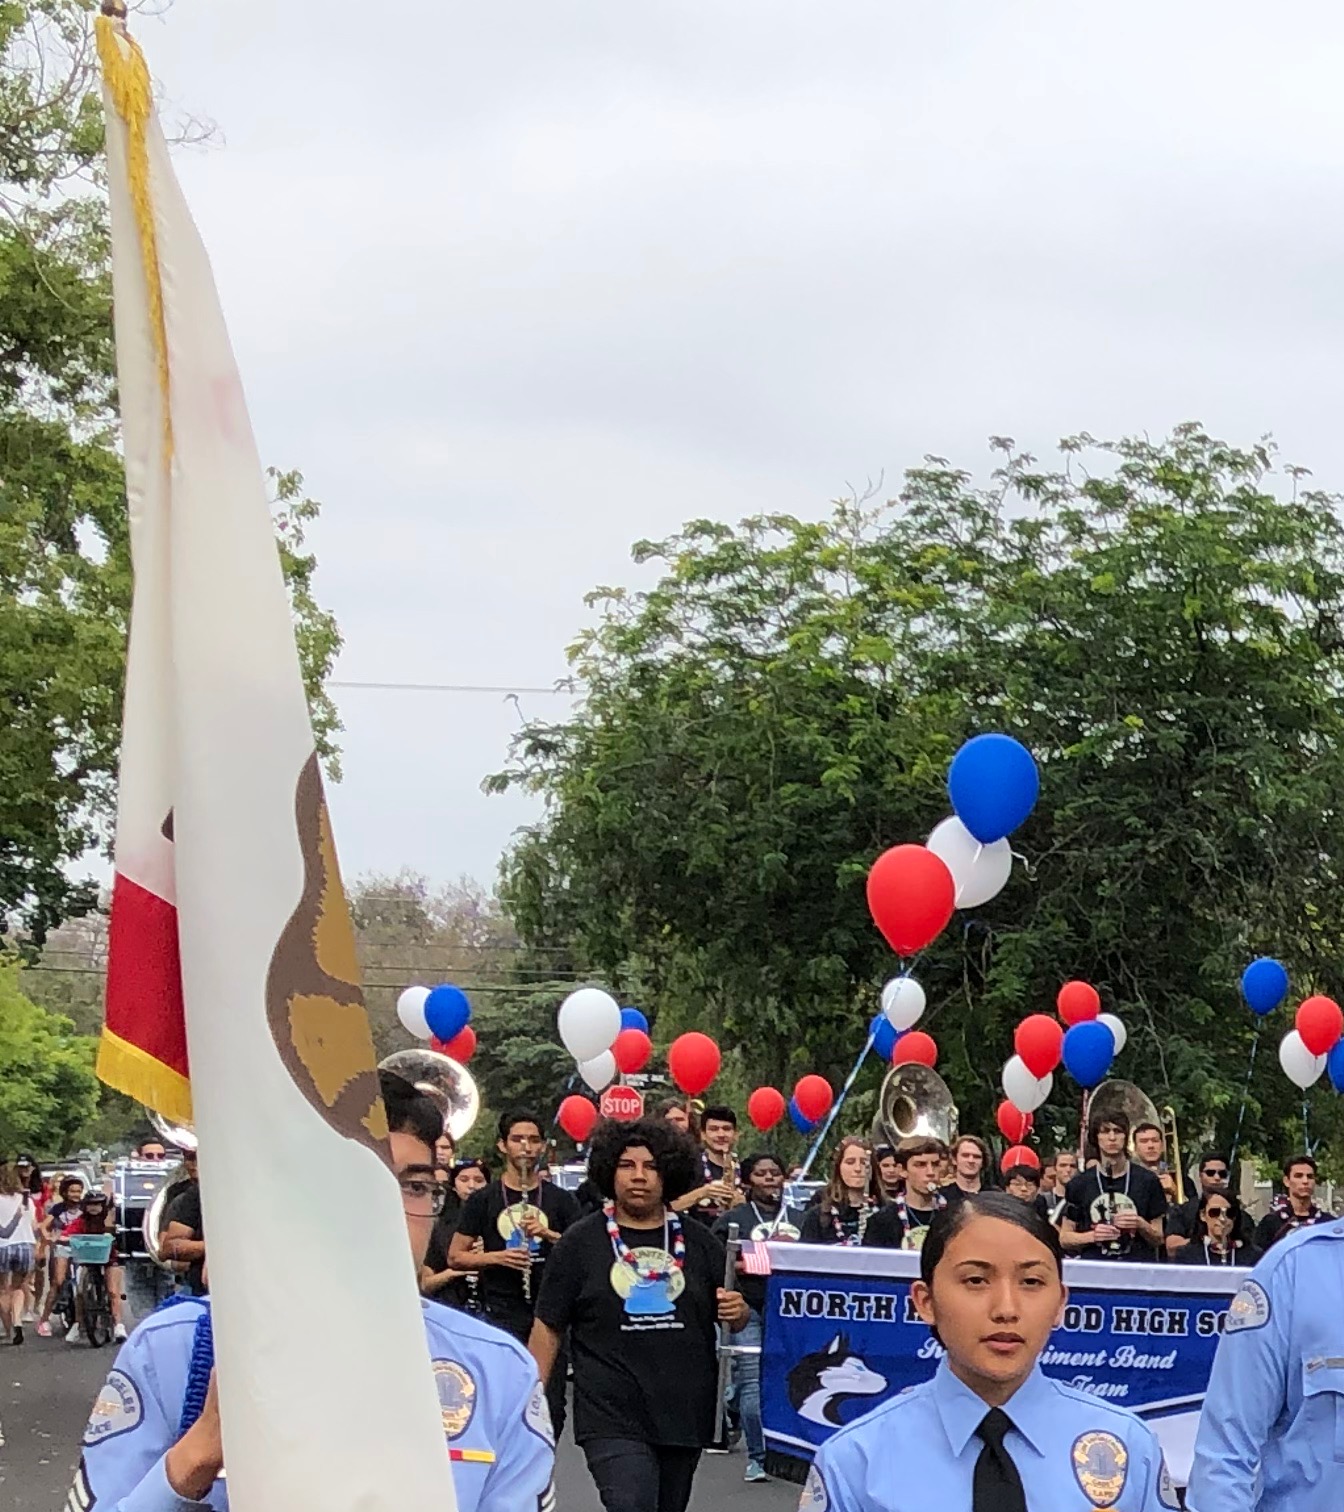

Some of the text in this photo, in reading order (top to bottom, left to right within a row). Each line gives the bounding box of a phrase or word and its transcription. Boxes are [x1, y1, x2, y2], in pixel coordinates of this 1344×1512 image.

[604, 1097, 640, 1114] STOP
[780, 1288, 897, 1323] NORTH
[1111, 1306, 1189, 1337] HIGH
[1109, 1344, 1178, 1370] Band
[1065, 1374, 1129, 1397] Team
